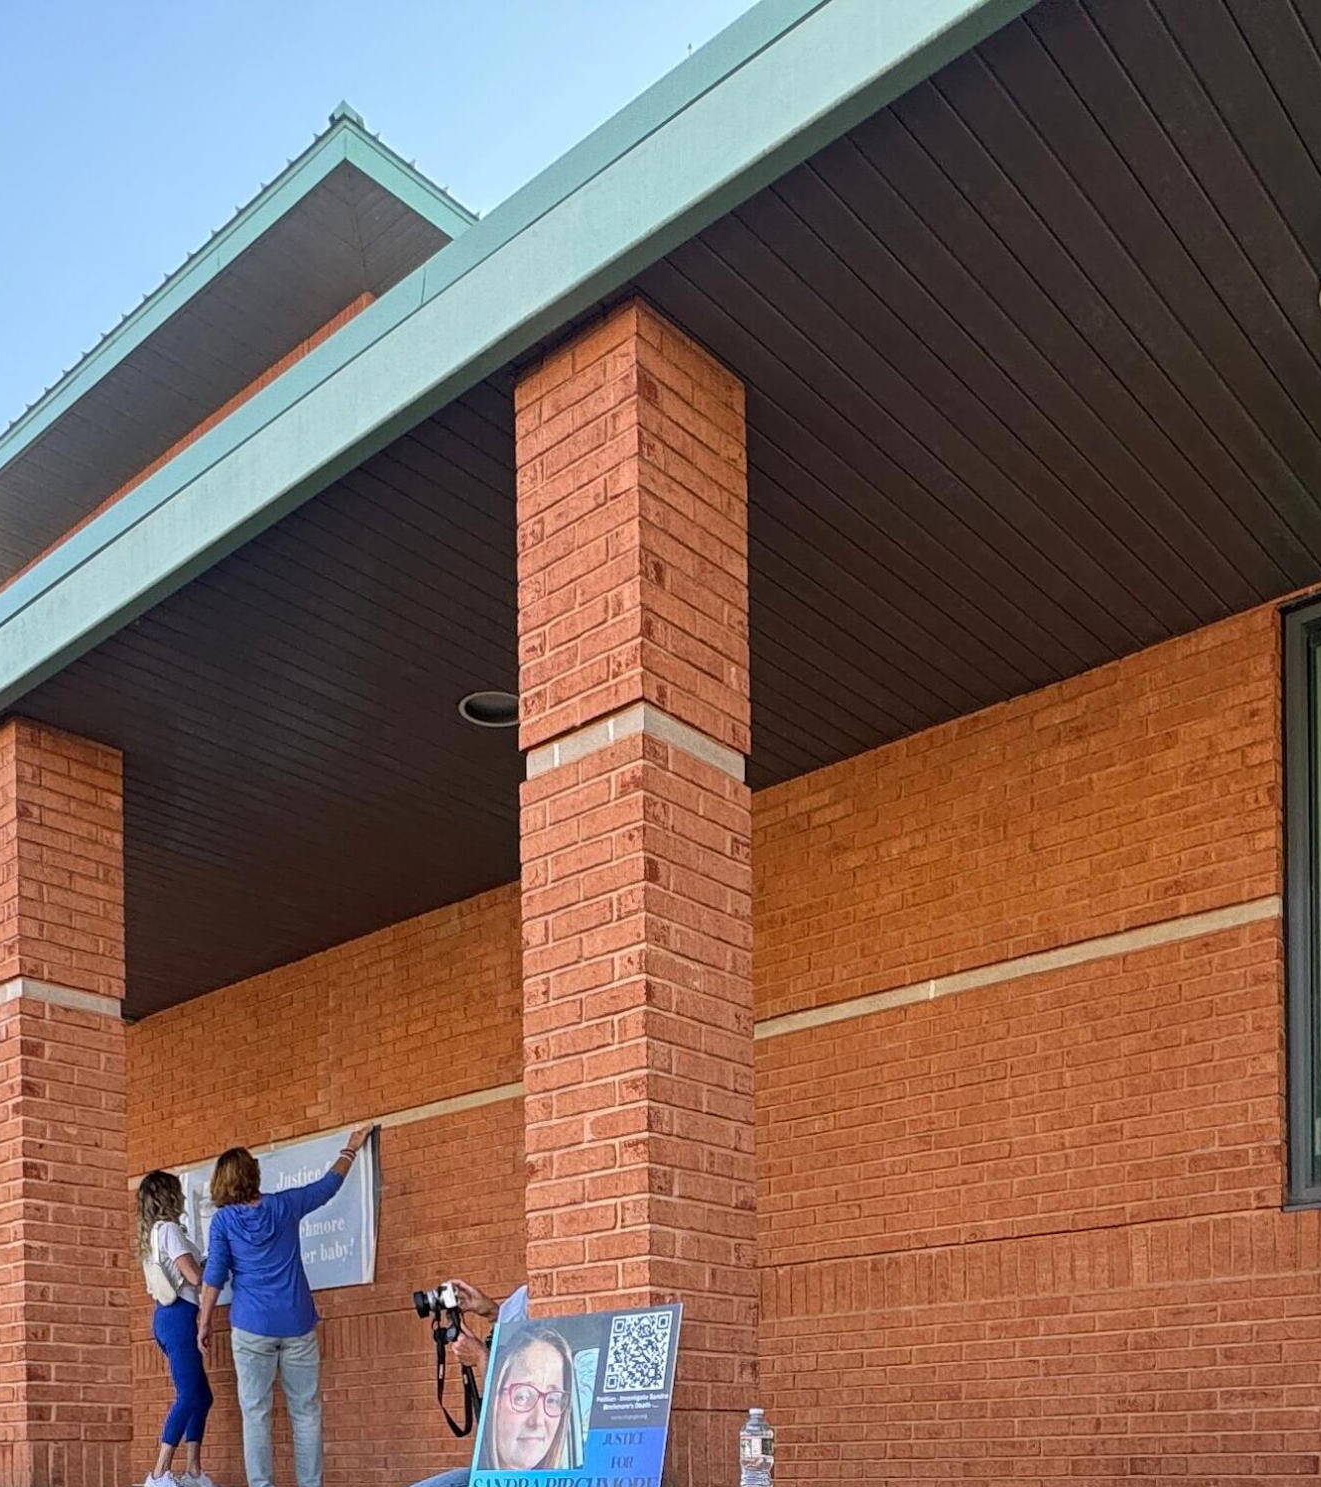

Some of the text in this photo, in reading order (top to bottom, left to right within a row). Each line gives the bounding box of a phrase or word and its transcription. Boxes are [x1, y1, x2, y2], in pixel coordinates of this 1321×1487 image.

[276, 1165, 321, 1189] Justice
[301, 1217, 346, 1237] hmore
[304, 1237, 355, 1265] er baby!
[602, 1431, 645, 1446] JUSTICE
[610, 1455, 634, 1469] FOR
